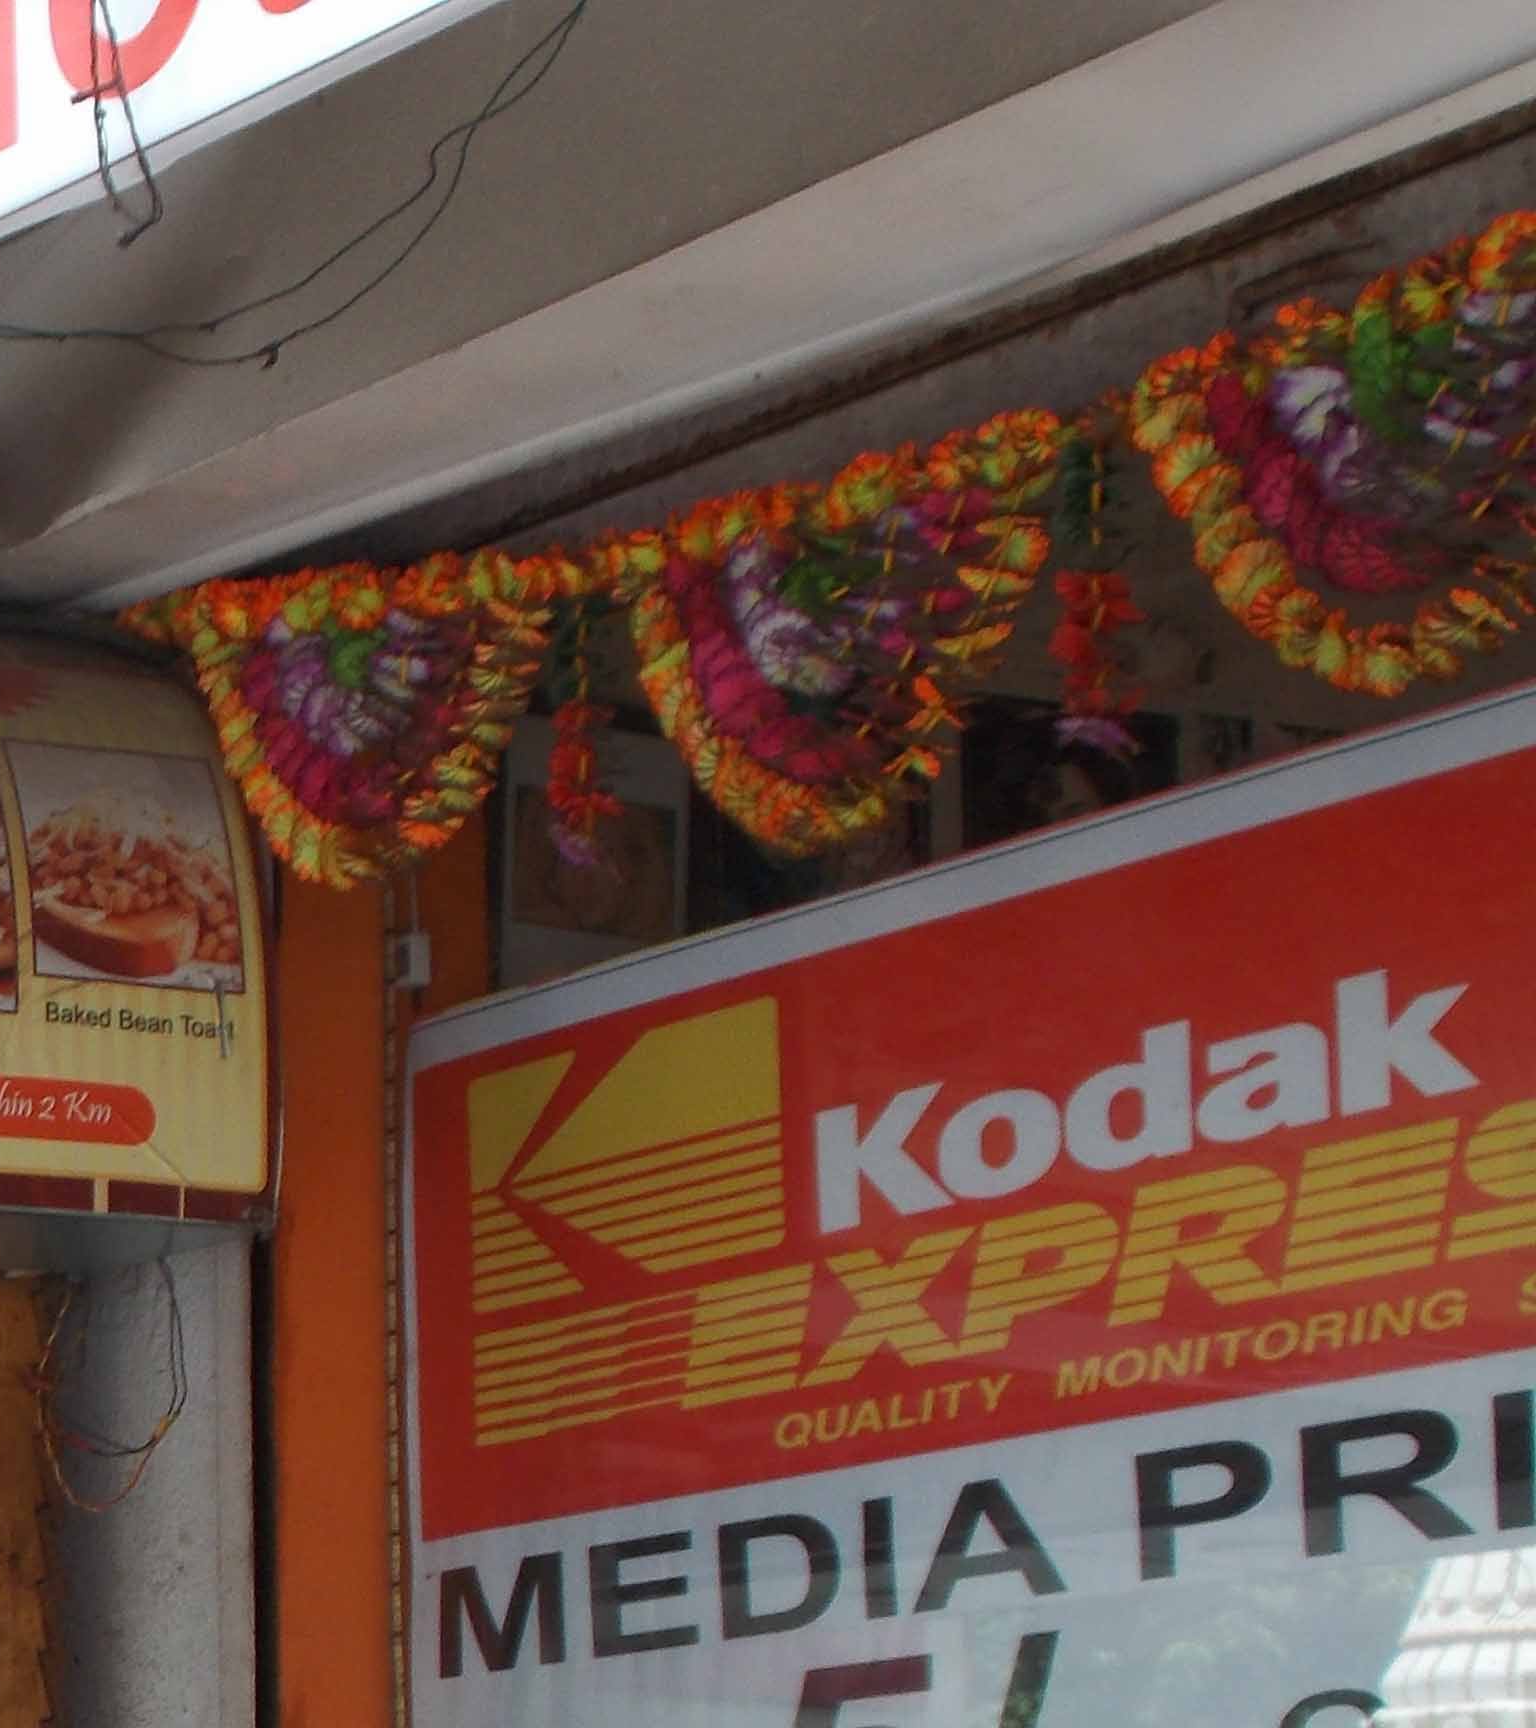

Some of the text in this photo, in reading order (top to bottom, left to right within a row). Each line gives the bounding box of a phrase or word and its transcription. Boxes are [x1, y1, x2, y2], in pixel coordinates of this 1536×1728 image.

[45, 1000, 112, 1029] Baked
[118, 1008, 174, 1034] Bean
[39, 1095, 56, 1121] 2
[62, 1092, 112, 1124] Km
[814, 970, 1480, 1236] Kodak
[775, 1373, 1012, 1449] QUALITY
[1056, 1288, 1468, 1400] MONITORING
[438, 1478, 1067, 1681] MEDIA
